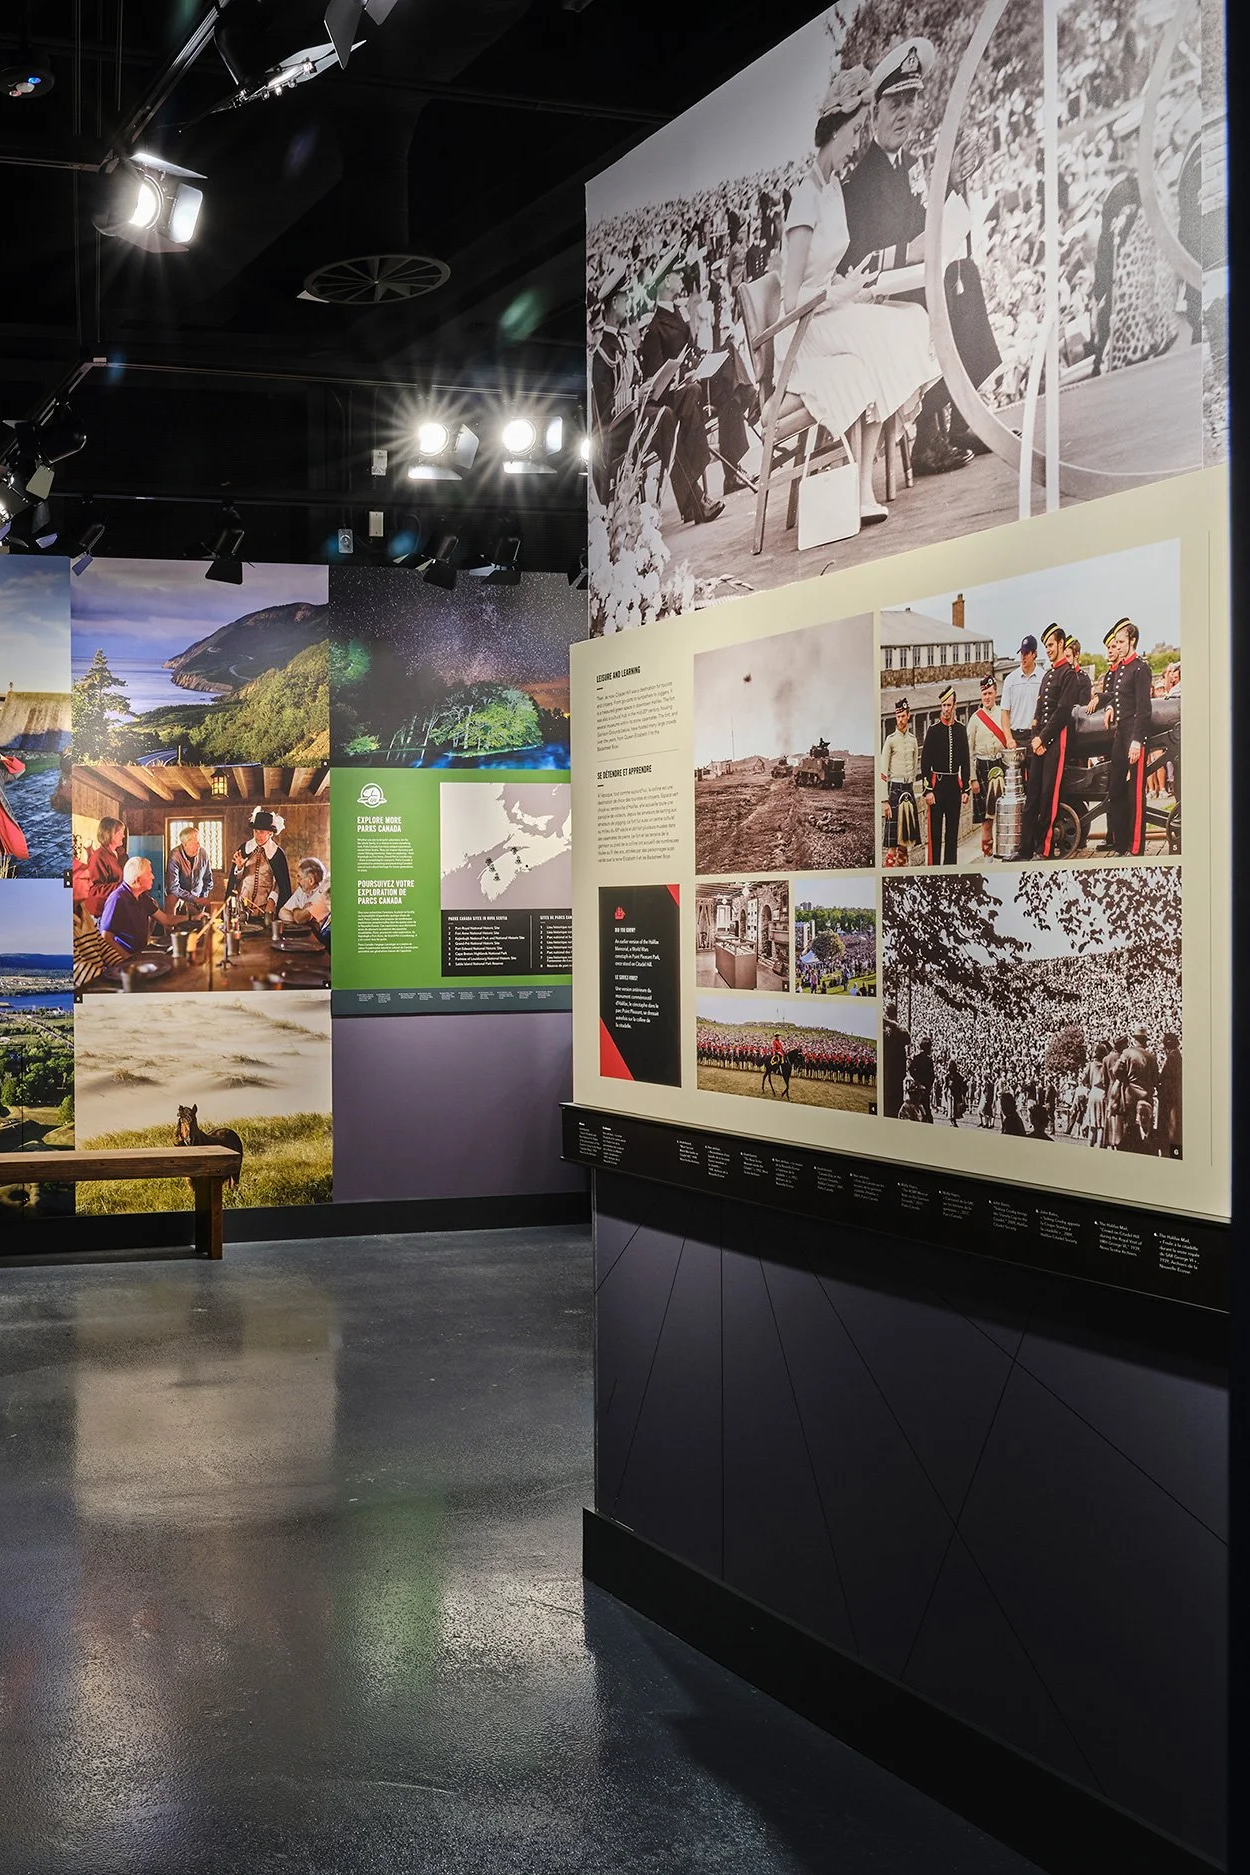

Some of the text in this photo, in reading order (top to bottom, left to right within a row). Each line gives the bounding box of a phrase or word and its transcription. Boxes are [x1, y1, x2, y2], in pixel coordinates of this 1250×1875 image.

[597, 672, 612, 683] LEISURE
[621, 666, 640, 677] LEARNING
[597, 765, 652, 779] SE DÉTENDRE ET APPRENDRE
